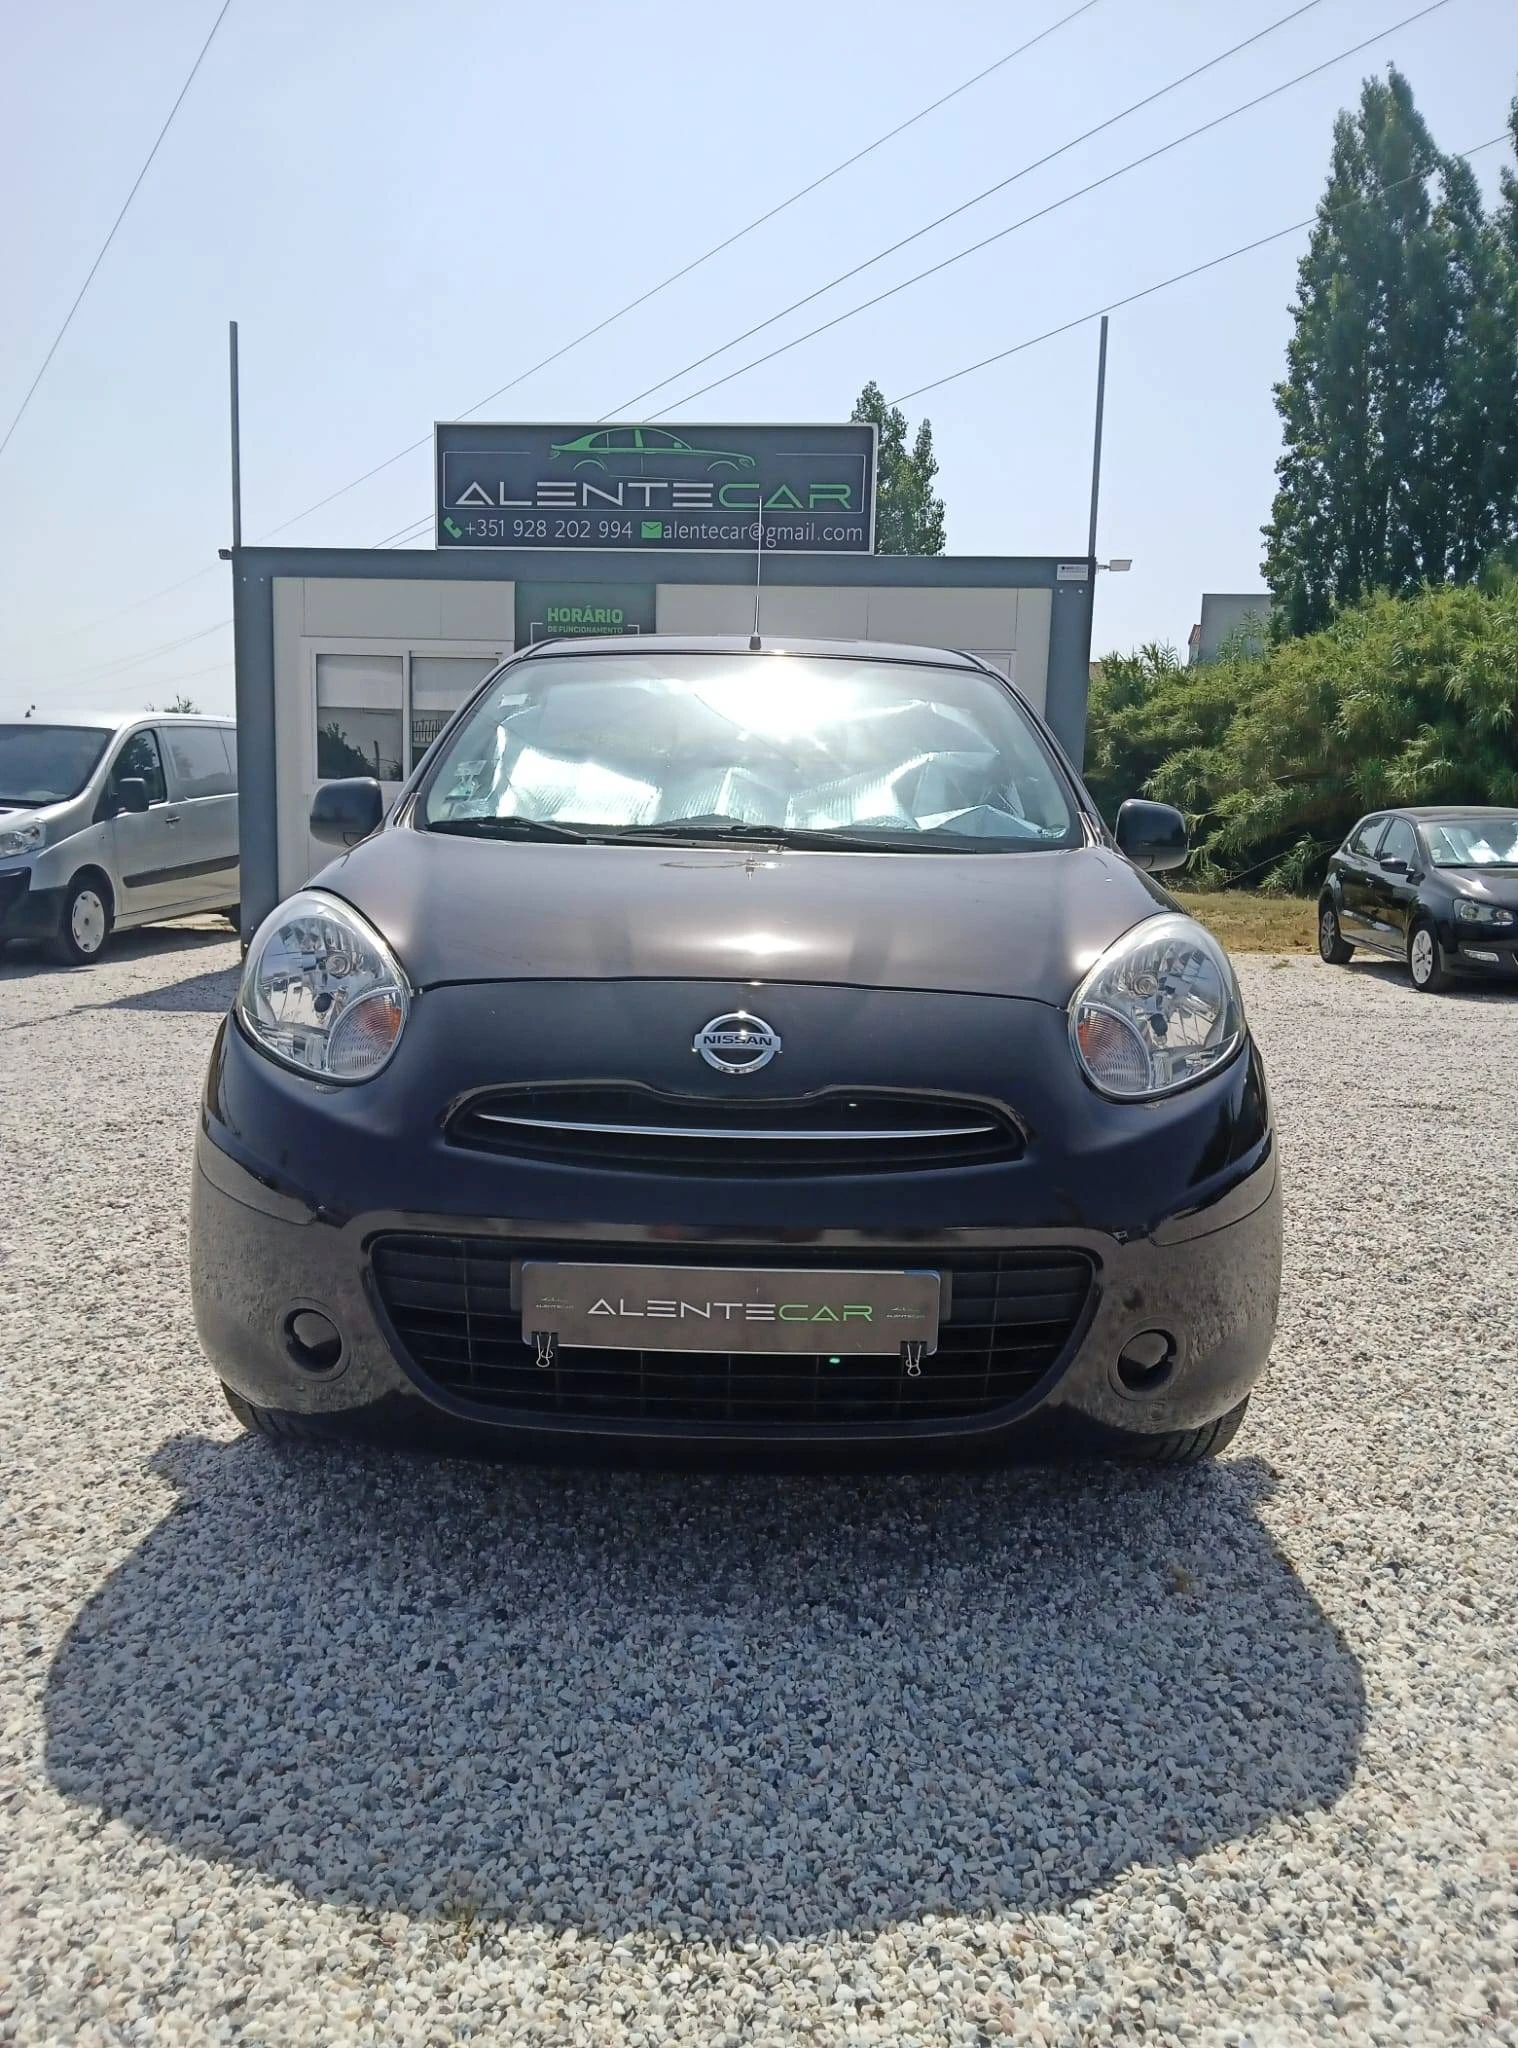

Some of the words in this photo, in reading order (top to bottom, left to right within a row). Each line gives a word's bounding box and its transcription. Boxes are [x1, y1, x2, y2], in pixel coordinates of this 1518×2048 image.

[455, 480, 852, 510] ALENTECAR
[465, 519, 505, 538] +351
[513, 519, 547, 538] 928
[555, 520, 591, 539] 202
[599, 520, 633, 540] 994
[663, 520, 863, 549] alentecar@gmail.com
[547, 604, 624, 624] HORÁRIO
[547, 625, 558, 634] DE
[559, 625, 623, 635] FUNCIONAMENTO
[703, 1035, 772, 1047] NISSAN
[587, 1298, 873, 1322] ALENTECAR
